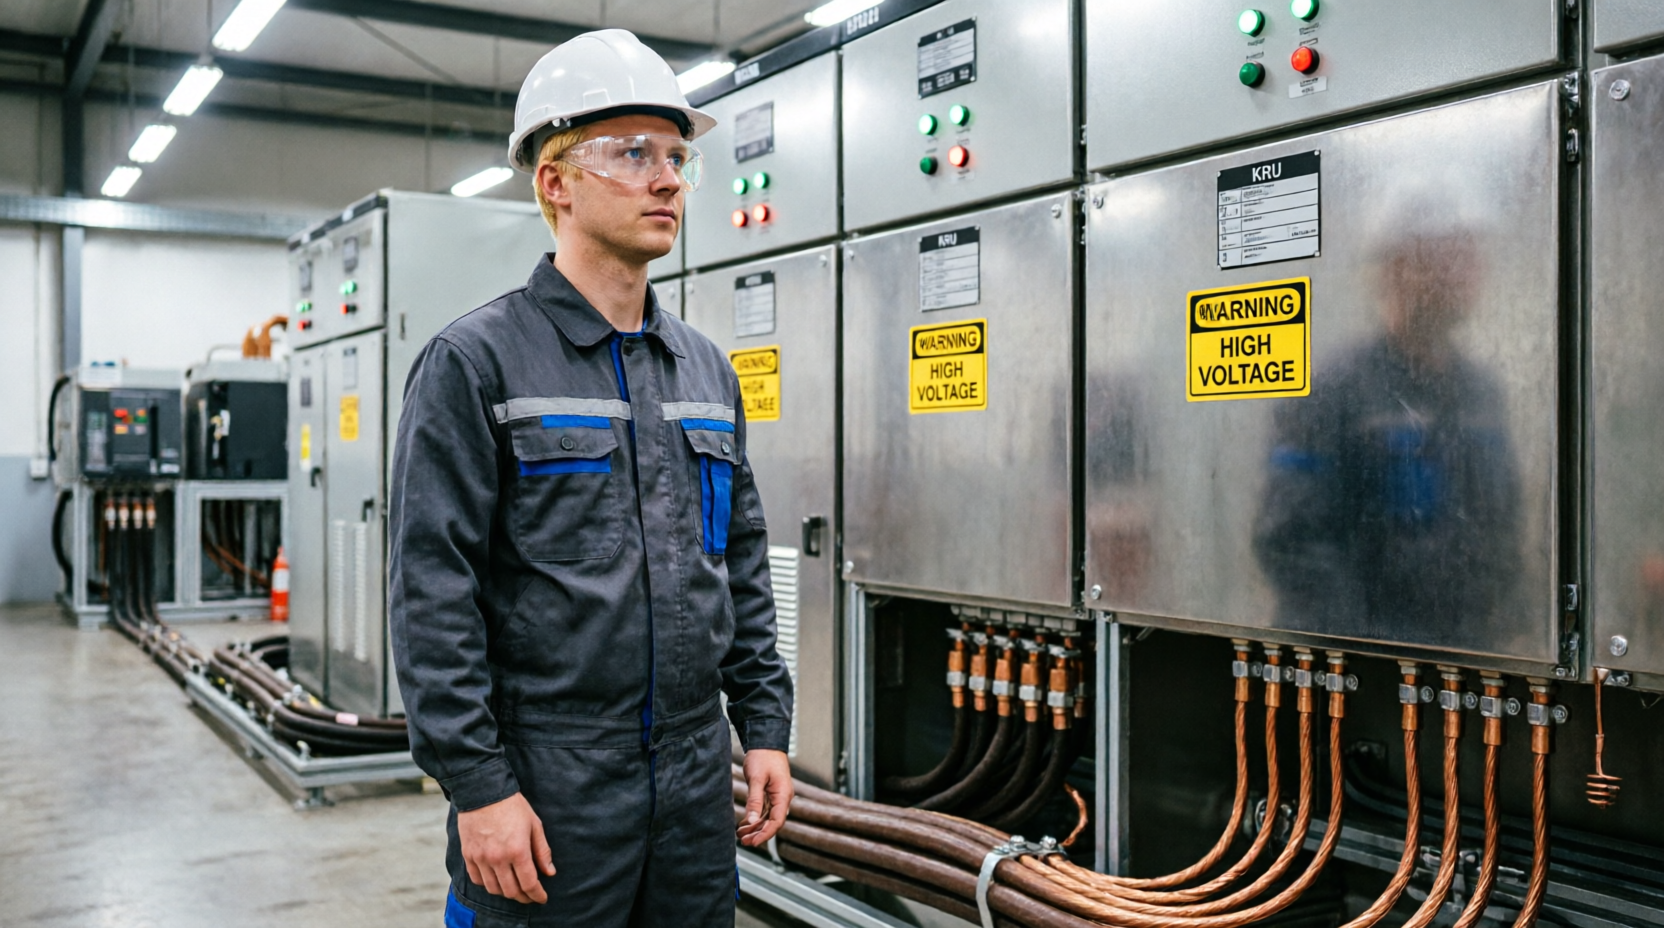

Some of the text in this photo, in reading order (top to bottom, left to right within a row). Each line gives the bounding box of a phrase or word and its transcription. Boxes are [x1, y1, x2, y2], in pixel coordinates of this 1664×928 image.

[1252, 162, 1282, 182] KRU
[1221, 333, 1271, 358] HIGH
[930, 361, 963, 379] HIGH
[1198, 360, 1295, 387] VOLTAGE
[917, 382, 978, 401] VOLTAGE
